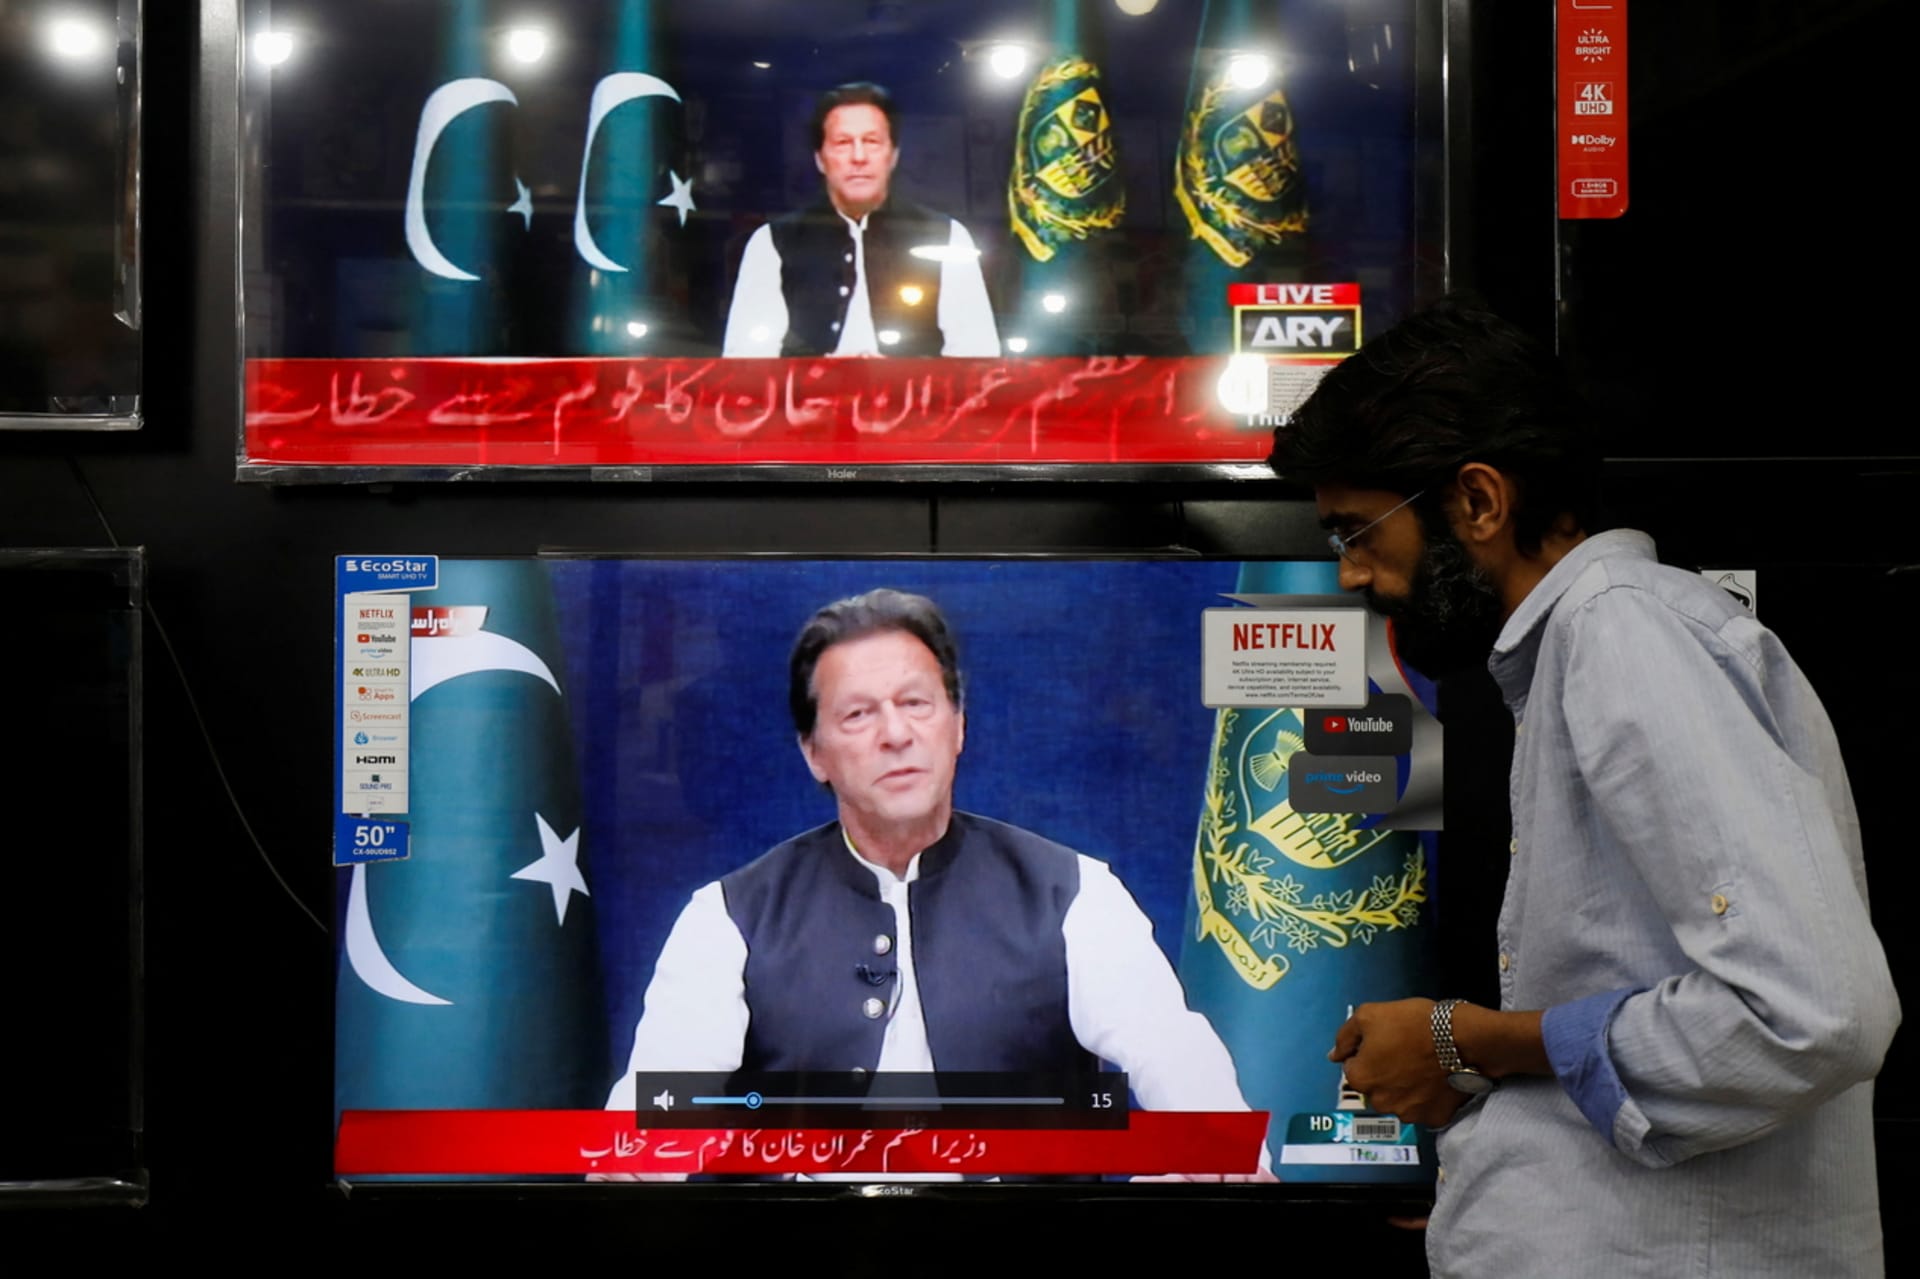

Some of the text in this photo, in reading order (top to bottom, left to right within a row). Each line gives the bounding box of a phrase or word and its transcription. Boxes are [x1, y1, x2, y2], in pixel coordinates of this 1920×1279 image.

[1577, 35, 1610, 44] ULTRA
[1575, 47, 1612, 55] BRIGHT
[1580, 84, 1607, 101] 4K
[1579, 102, 1608, 114] UHD
[1586, 135, 1616, 147] Dolby
[1256, 284, 1335, 305] LIVE
[1250, 316, 1345, 347] ARY
[826, 468, 857, 479] Haier
[360, 560, 428, 572] EcoStar
[359, 609, 394, 619] NETFLIX
[371, 634, 396, 643] YouTube
[1233, 623, 1336, 652] NETFLIX
[352, 667, 364, 676] 4K
[386, 667, 401, 676] HD
[362, 712, 402, 721] Screencast
[1347, 717, 1394, 733] YouTube
[1304, 770, 1382, 785] prime video
[1091, 1093, 1113, 1109] 15
[1310, 1116, 1333, 1131] HD
[579, 1129, 648, 1168] خطاب
[653, 1140, 695, 1158] سے
[761, 1132, 806, 1163] خان
[812, 1129, 875, 1167] عمران
